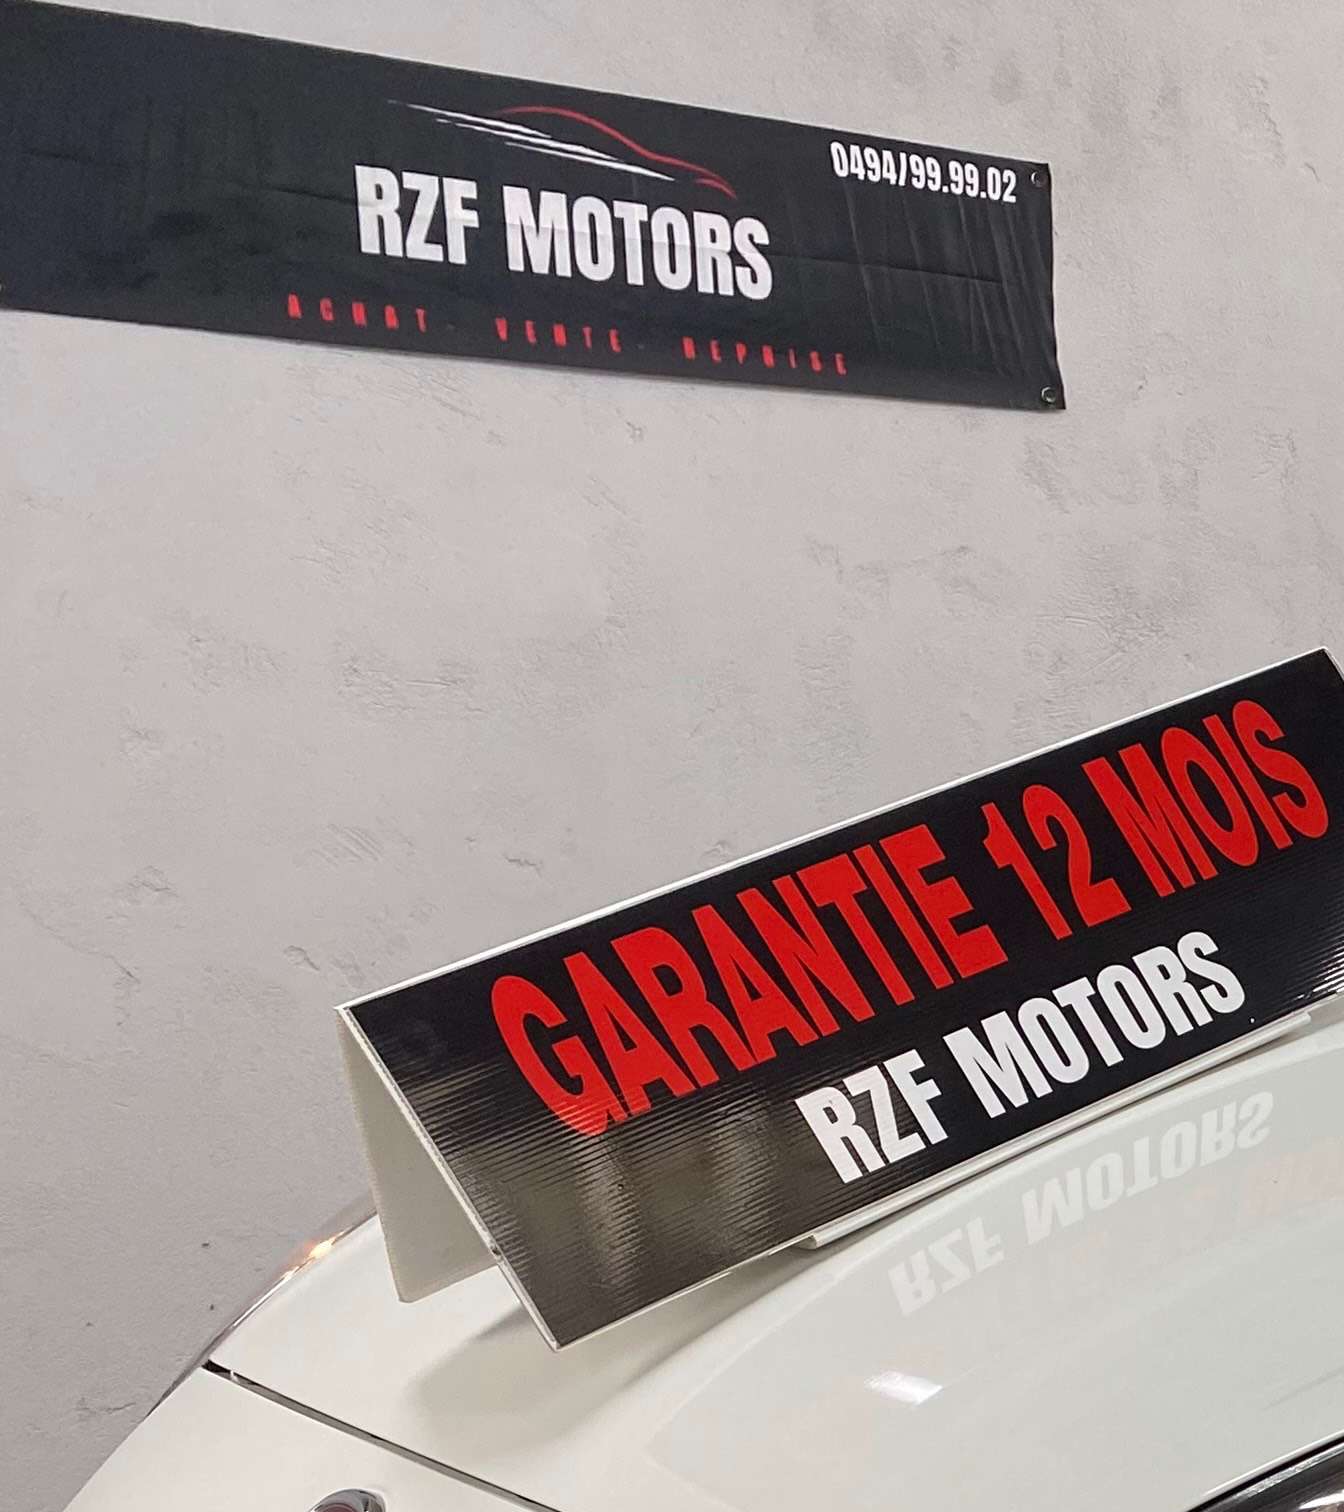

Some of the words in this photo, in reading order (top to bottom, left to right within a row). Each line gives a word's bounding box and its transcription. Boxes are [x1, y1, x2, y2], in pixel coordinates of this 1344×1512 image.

[354, 164, 480, 265] RZF
[502, 185, 773, 300] MOTORS
[829, 141, 1018, 205] 0494/99.99.02
[490, 823, 1008, 1137] GARANTIE
[982, 783, 1131, 941] 12
[1081, 699, 1330, 897] MOIS
[794, 1047, 949, 1184] RZF
[942, 930, 1245, 1119] MOTORS
